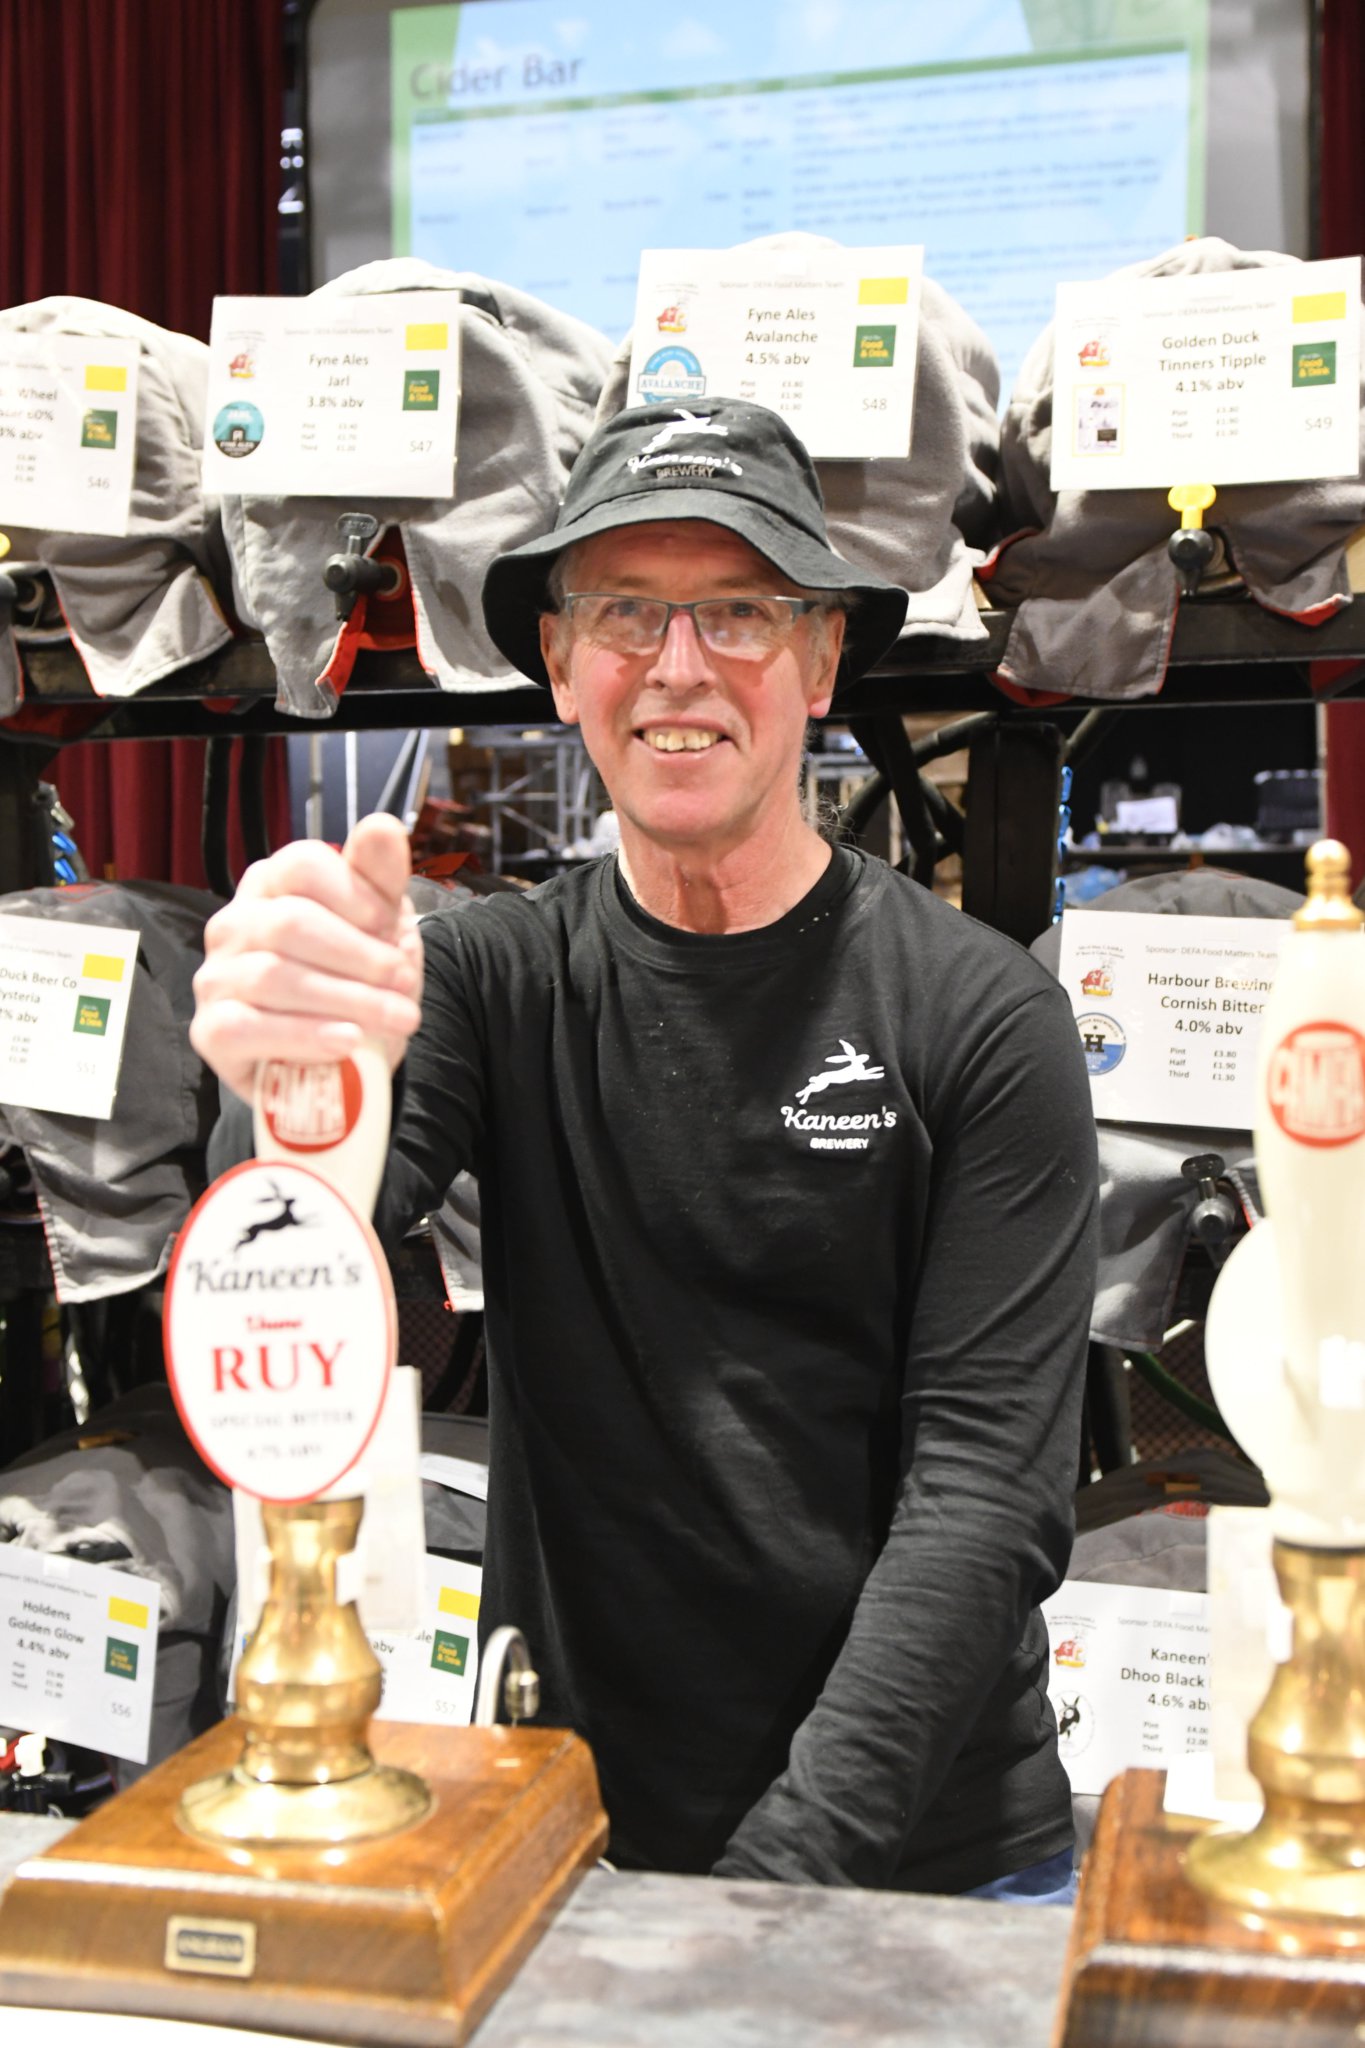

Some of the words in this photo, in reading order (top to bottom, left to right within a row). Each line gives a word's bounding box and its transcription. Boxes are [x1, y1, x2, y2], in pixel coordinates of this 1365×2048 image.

[409, 60, 511, 99] Cider
[521, 53, 586, 89] Bar
[748, 308, 781, 323] Fyne
[786, 307, 816, 321] Ales
[745, 330, 819, 343] Avalanche
[1161, 335, 1217, 350] Golden
[1222, 330, 1260, 346] Duck
[309, 354, 339, 368] Fyne
[343, 353, 369, 366] Ales
[745, 352, 779, 365] 4.5%
[784, 352, 811, 365] abv
[1159, 358, 1215, 372] Tinners
[1219, 353, 1267, 370] Tipple
[328, 374, 350, 388] Jarl
[641, 379, 703, 390] AVALANCHE
[1175, 379, 1212, 393] 4.1%
[1217, 377, 1245, 391] abv
[18, 387, 58, 401] Wheel
[307, 395, 337, 408] 3.8%
[341, 395, 364, 408] abv
[862, 398, 887, 411] S48
[1305, 415, 1333, 431] S49
[410, 440, 433, 452] S47
[656, 465, 715, 480] BREWERY
[0, 966, 28, 981] Duck
[32, 970, 59, 986] Beer
[62, 975, 78, 989] Co
[1148, 972, 1210, 989] Harbour
[0, 988, 41, 1004] ysteria
[1160, 995, 1218, 1012] Cornish
[1222, 998, 1265, 1015] Bitter
[16, 1011, 39, 1024] abv
[1175, 1019, 1211, 1034] 4.0%
[1216, 1020, 1243, 1036] abv
[1170, 1046, 1186, 1055] Pint
[1213, 1050, 1237, 1059] £3.80
[1169, 1058, 1186, 1067] Half
[1213, 1061, 1236, 1071] £1.90
[1168, 1070, 1190, 1080] Third
[780, 1105, 897, 1131] Kaneen's
[809, 1137, 869, 1149] BREWERY
[186, 1251, 363, 1294] Kaneen's
[210, 1339, 347, 1393] RUY
[22, 1599, 71, 1622] Holdens
[8, 1616, 51, 1636] Golden
[54, 1626, 85, 1645] Glow
[16, 1637, 46, 1655] 4.4%
[48, 1646, 71, 1660] abv
[372, 1639, 395, 1654] abv
[1150, 1648, 1212, 1666] Kaneen'
[1121, 1667, 1160, 1684] Dhoo
[1165, 1672, 1205, 1688] Black
[1147, 1693, 1184, 1709] 4.6%
